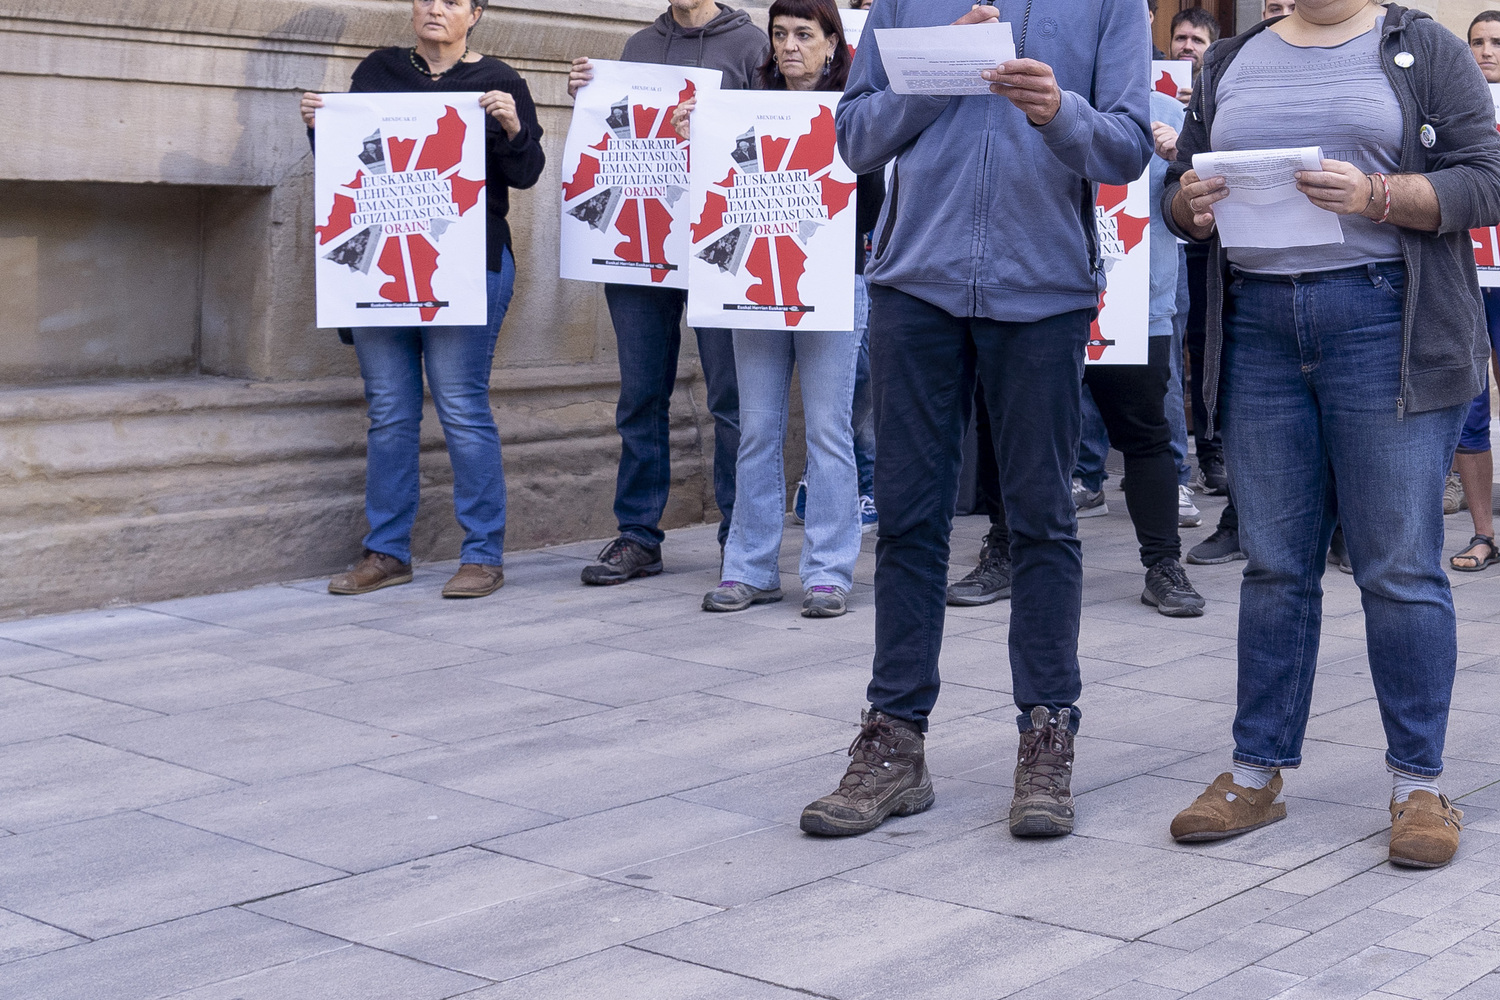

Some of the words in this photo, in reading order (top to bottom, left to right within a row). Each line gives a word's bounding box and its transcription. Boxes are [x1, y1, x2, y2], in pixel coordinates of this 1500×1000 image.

[609, 139, 675, 150] EUSKARARI
[601, 151, 687, 163] LEHENTASUNA
[602, 164, 653, 173] EMANEN
[656, 163, 685, 172] DION
[363, 171, 437, 188] EUSKARARI
[596, 174, 690, 185] OFIZIALTASUNA,
[735, 171, 807, 186] EUSKARARI
[356, 182, 450, 200] LEHENTASUNA
[624, 186, 666, 197] ORAIN!
[727, 183, 821, 199] LEHENTASUNA
[358, 197, 413, 212] EMANEN
[417, 194, 450, 206] DION
[729, 199, 783, 212] EMANEN
[787, 195, 820, 207] DION
[353, 206, 458, 225] OFIZIALTASUNA,
[724, 208, 827, 224] OFIZIALTASUNA,
[385, 221, 430, 234] ORAIN!
[754, 223, 798, 235] ORAIN!
[1100, 231, 1116, 242] ON
